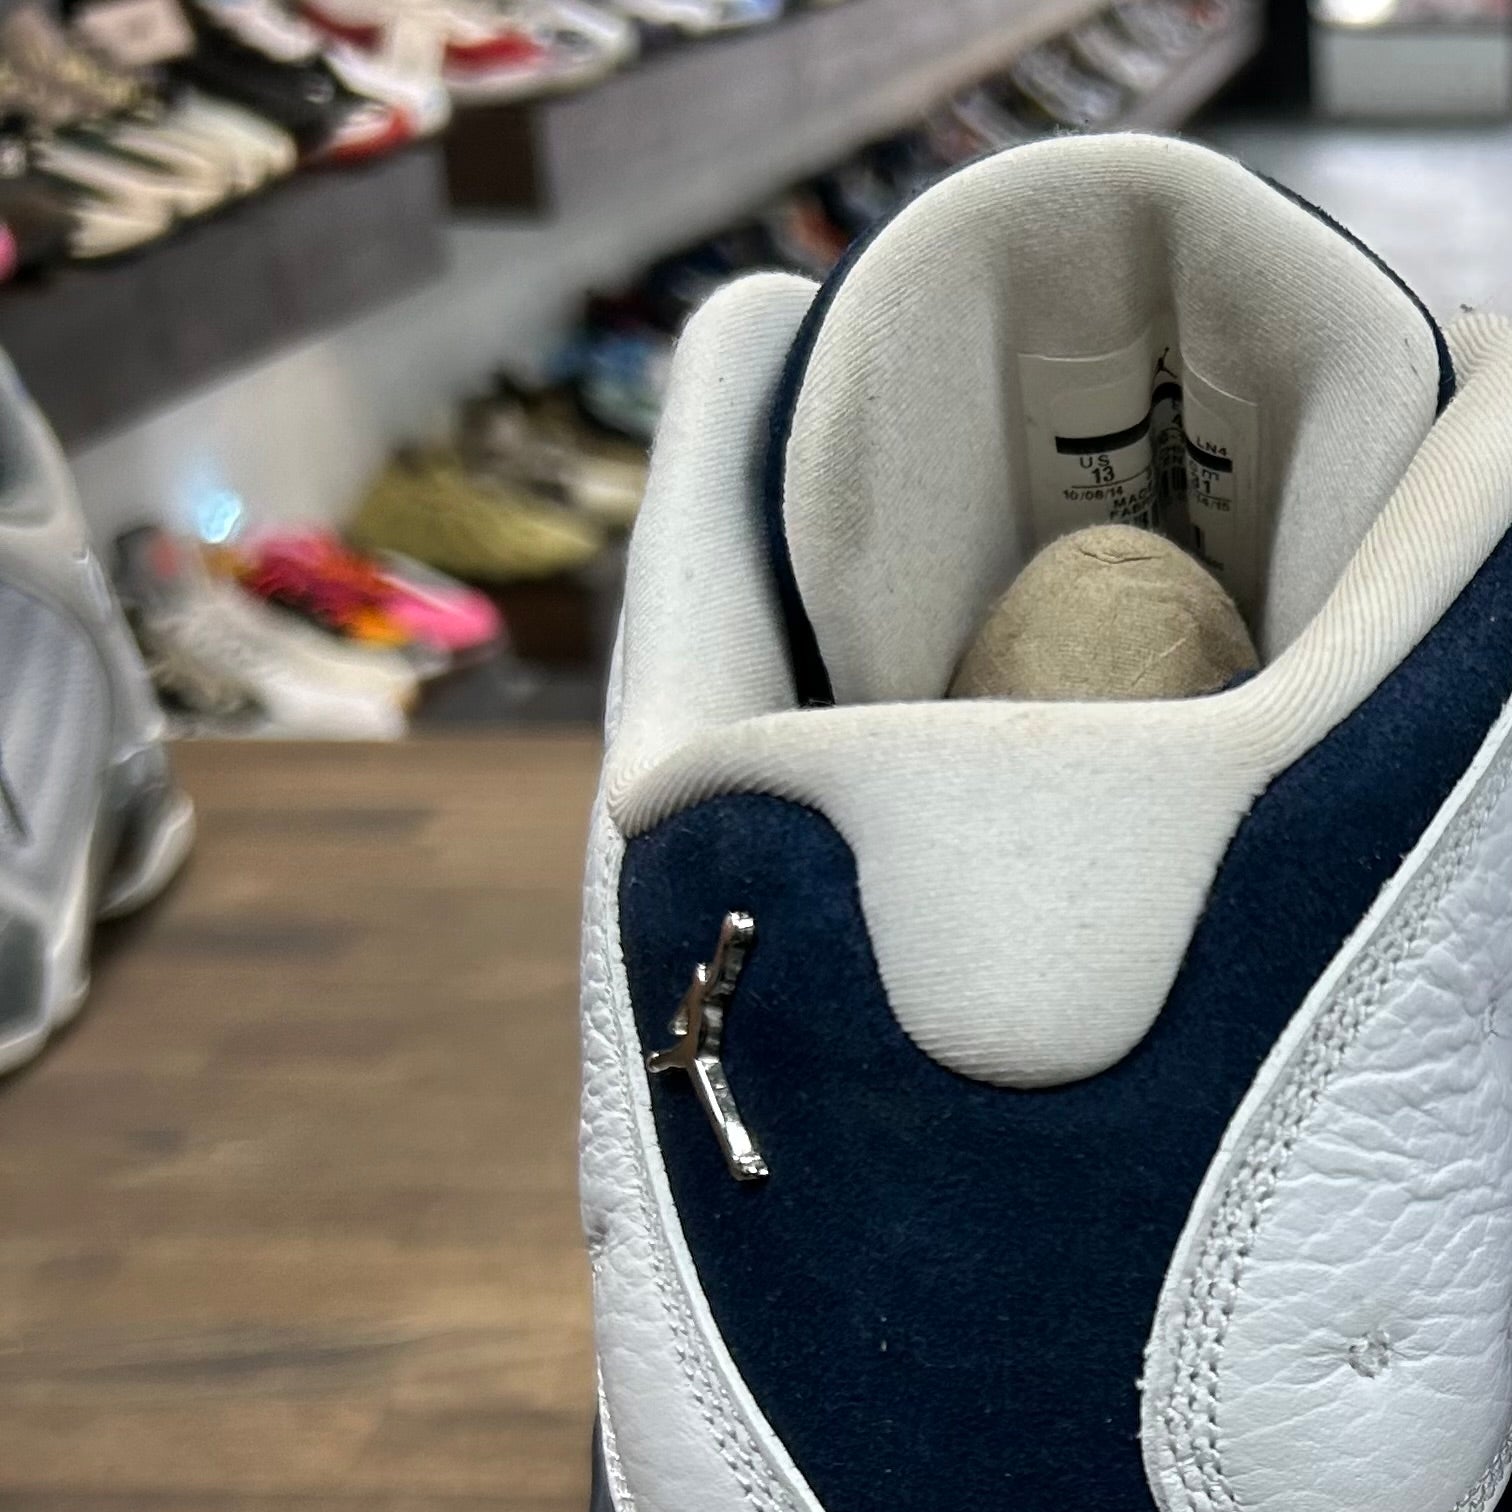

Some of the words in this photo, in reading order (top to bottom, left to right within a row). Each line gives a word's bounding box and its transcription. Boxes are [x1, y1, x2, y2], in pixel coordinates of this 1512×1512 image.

[1198, 436, 1227, 456] LN4
[1079, 454, 1111, 469] US
[1091, 465, 1116, 484] 13
